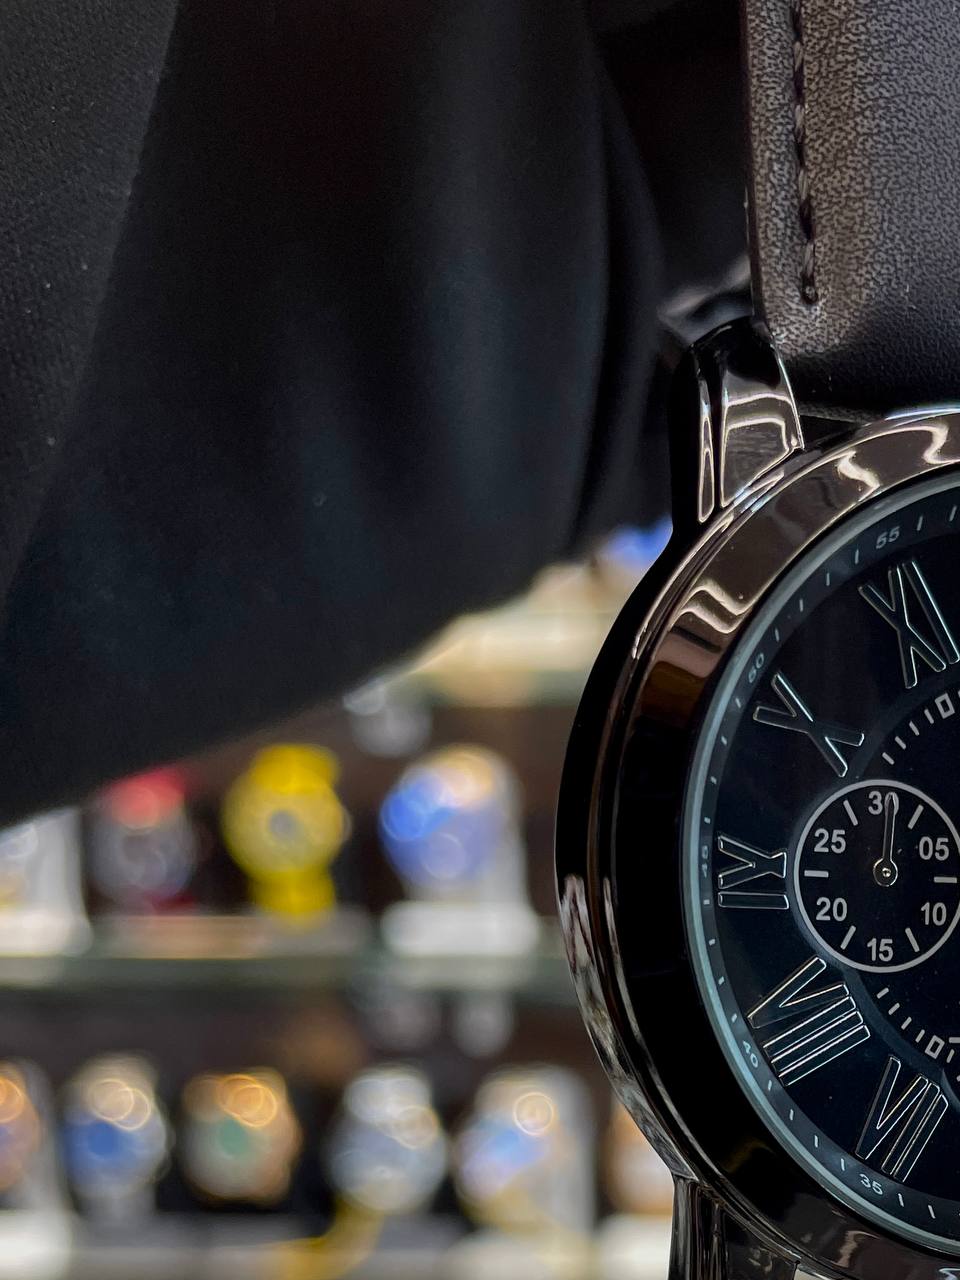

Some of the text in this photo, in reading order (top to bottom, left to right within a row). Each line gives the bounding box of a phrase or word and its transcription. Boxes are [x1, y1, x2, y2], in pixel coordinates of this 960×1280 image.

[813, 828, 847, 854] 25
[918, 836, 950, 861] 05
[815, 896, 848, 922] 20
[920, 901, 947, 927] 10
[866, 937, 894, 963] 15
[859, 1173, 884, 1196] 35
